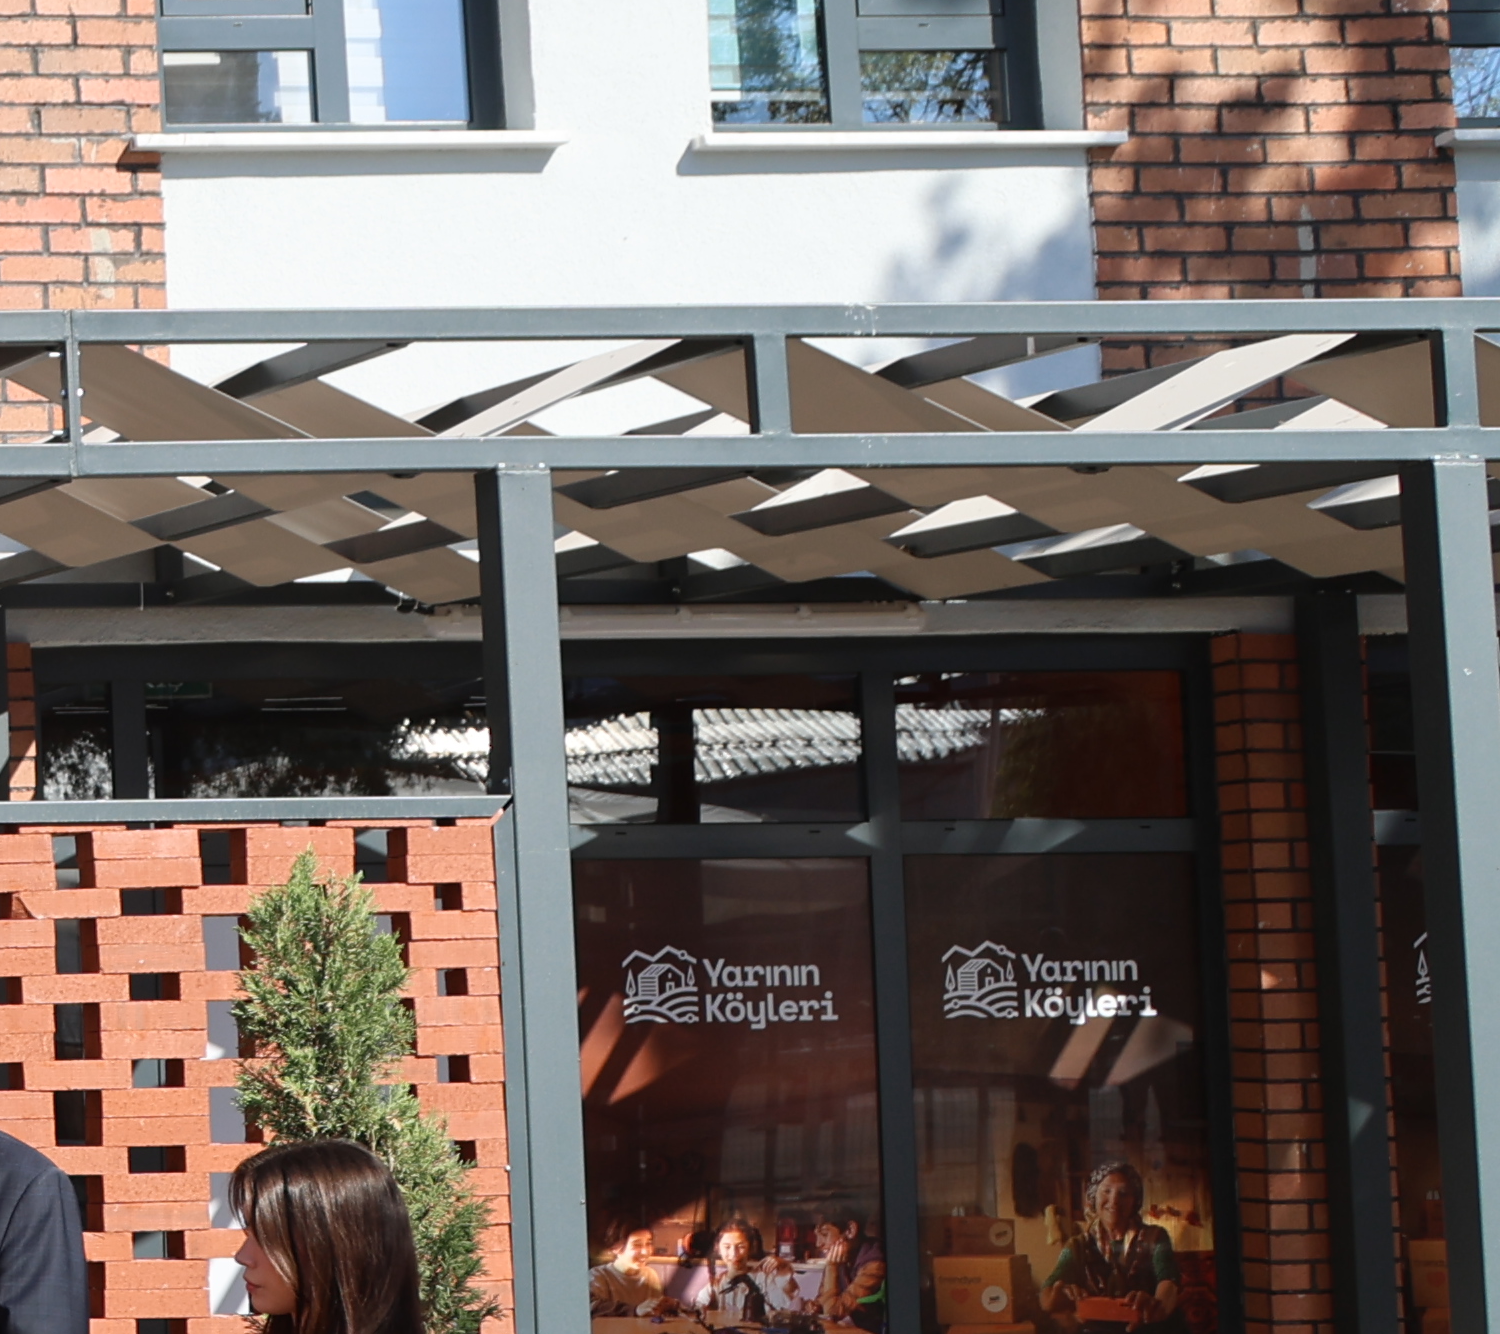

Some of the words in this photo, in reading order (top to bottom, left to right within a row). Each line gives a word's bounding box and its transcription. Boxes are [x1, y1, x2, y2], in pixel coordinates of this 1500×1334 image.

[702, 958, 820, 987] Yarının
[1021, 953, 1138, 982] Yarının
[706, 990, 839, 1030] Köyleri
[1025, 986, 1158, 1025] Köyleri
